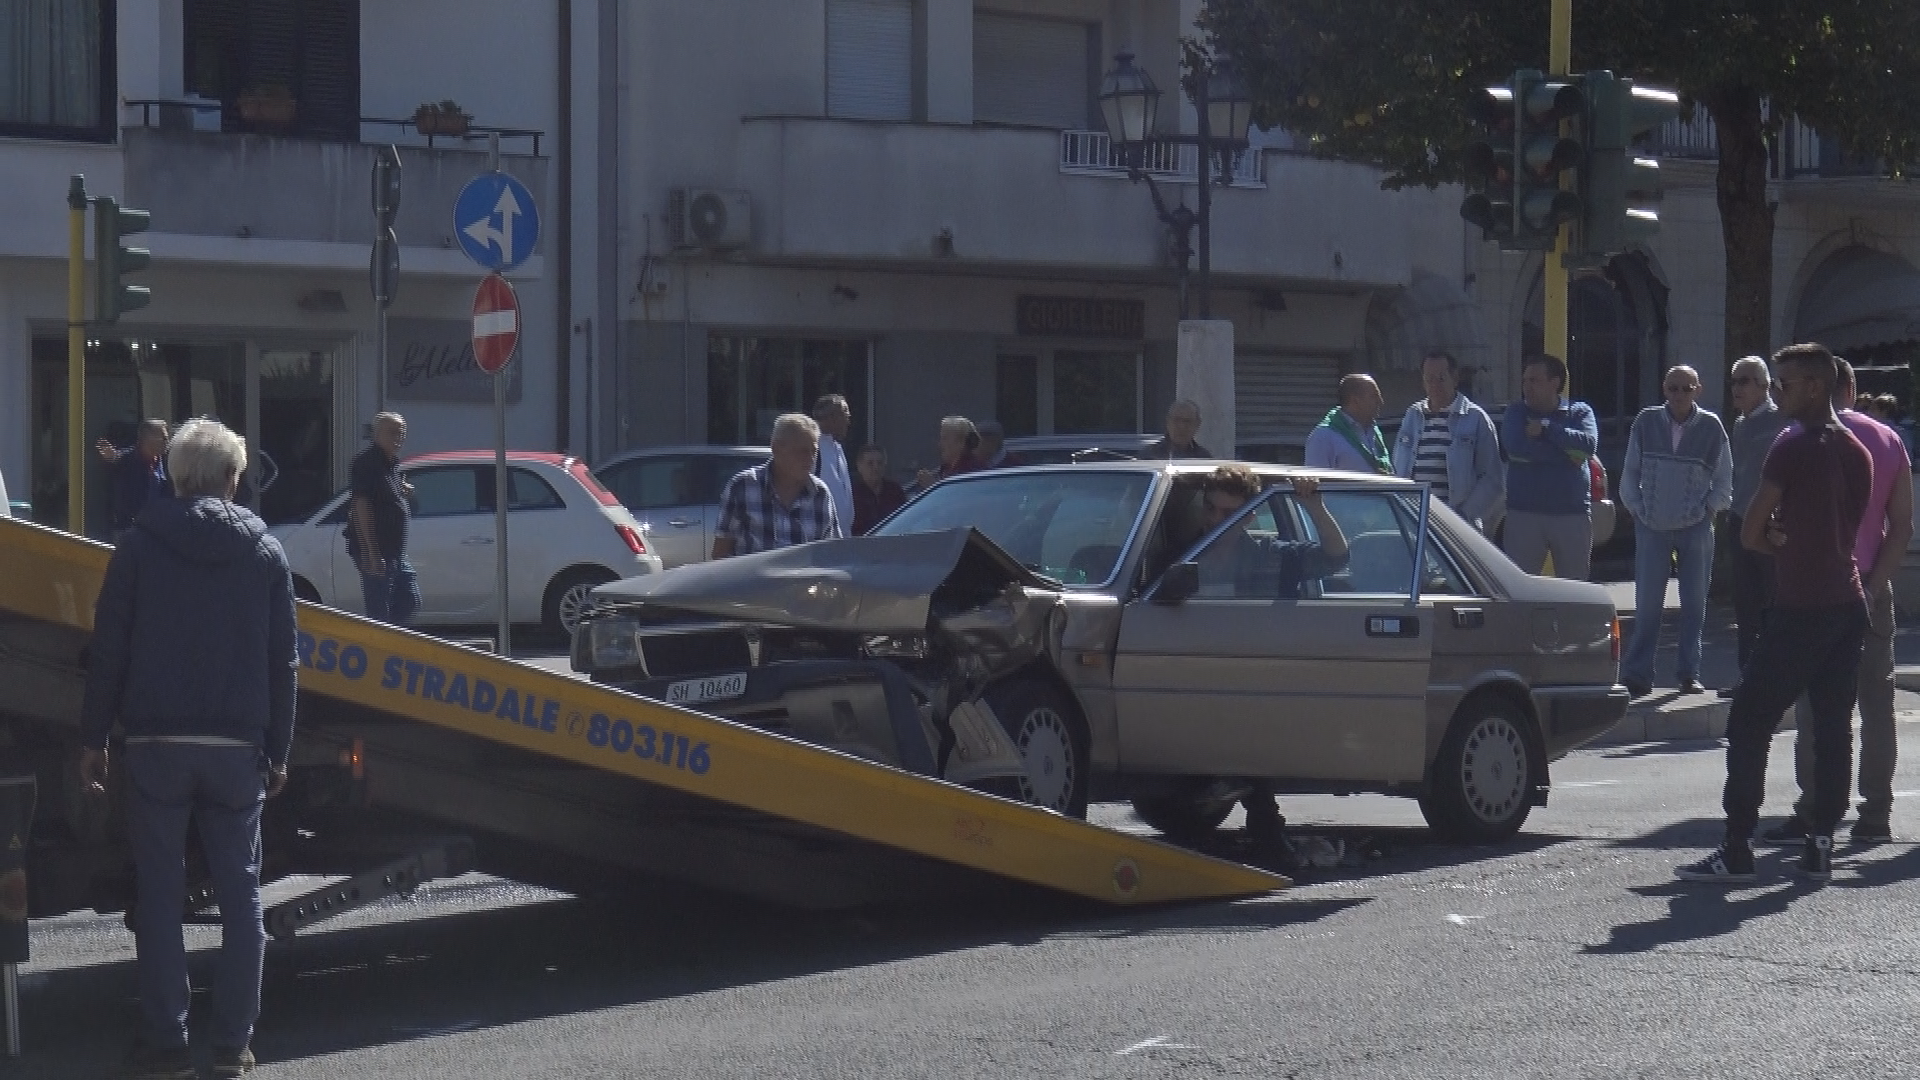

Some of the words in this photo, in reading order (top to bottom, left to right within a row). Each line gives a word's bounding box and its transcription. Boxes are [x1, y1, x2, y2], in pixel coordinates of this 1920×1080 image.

[1026, 301, 1143, 333] GIOIELLERIA
[672, 684, 689, 700] SH
[382, 655, 560, 734] STRADALE
[587, 712, 711, 776] 803.116
